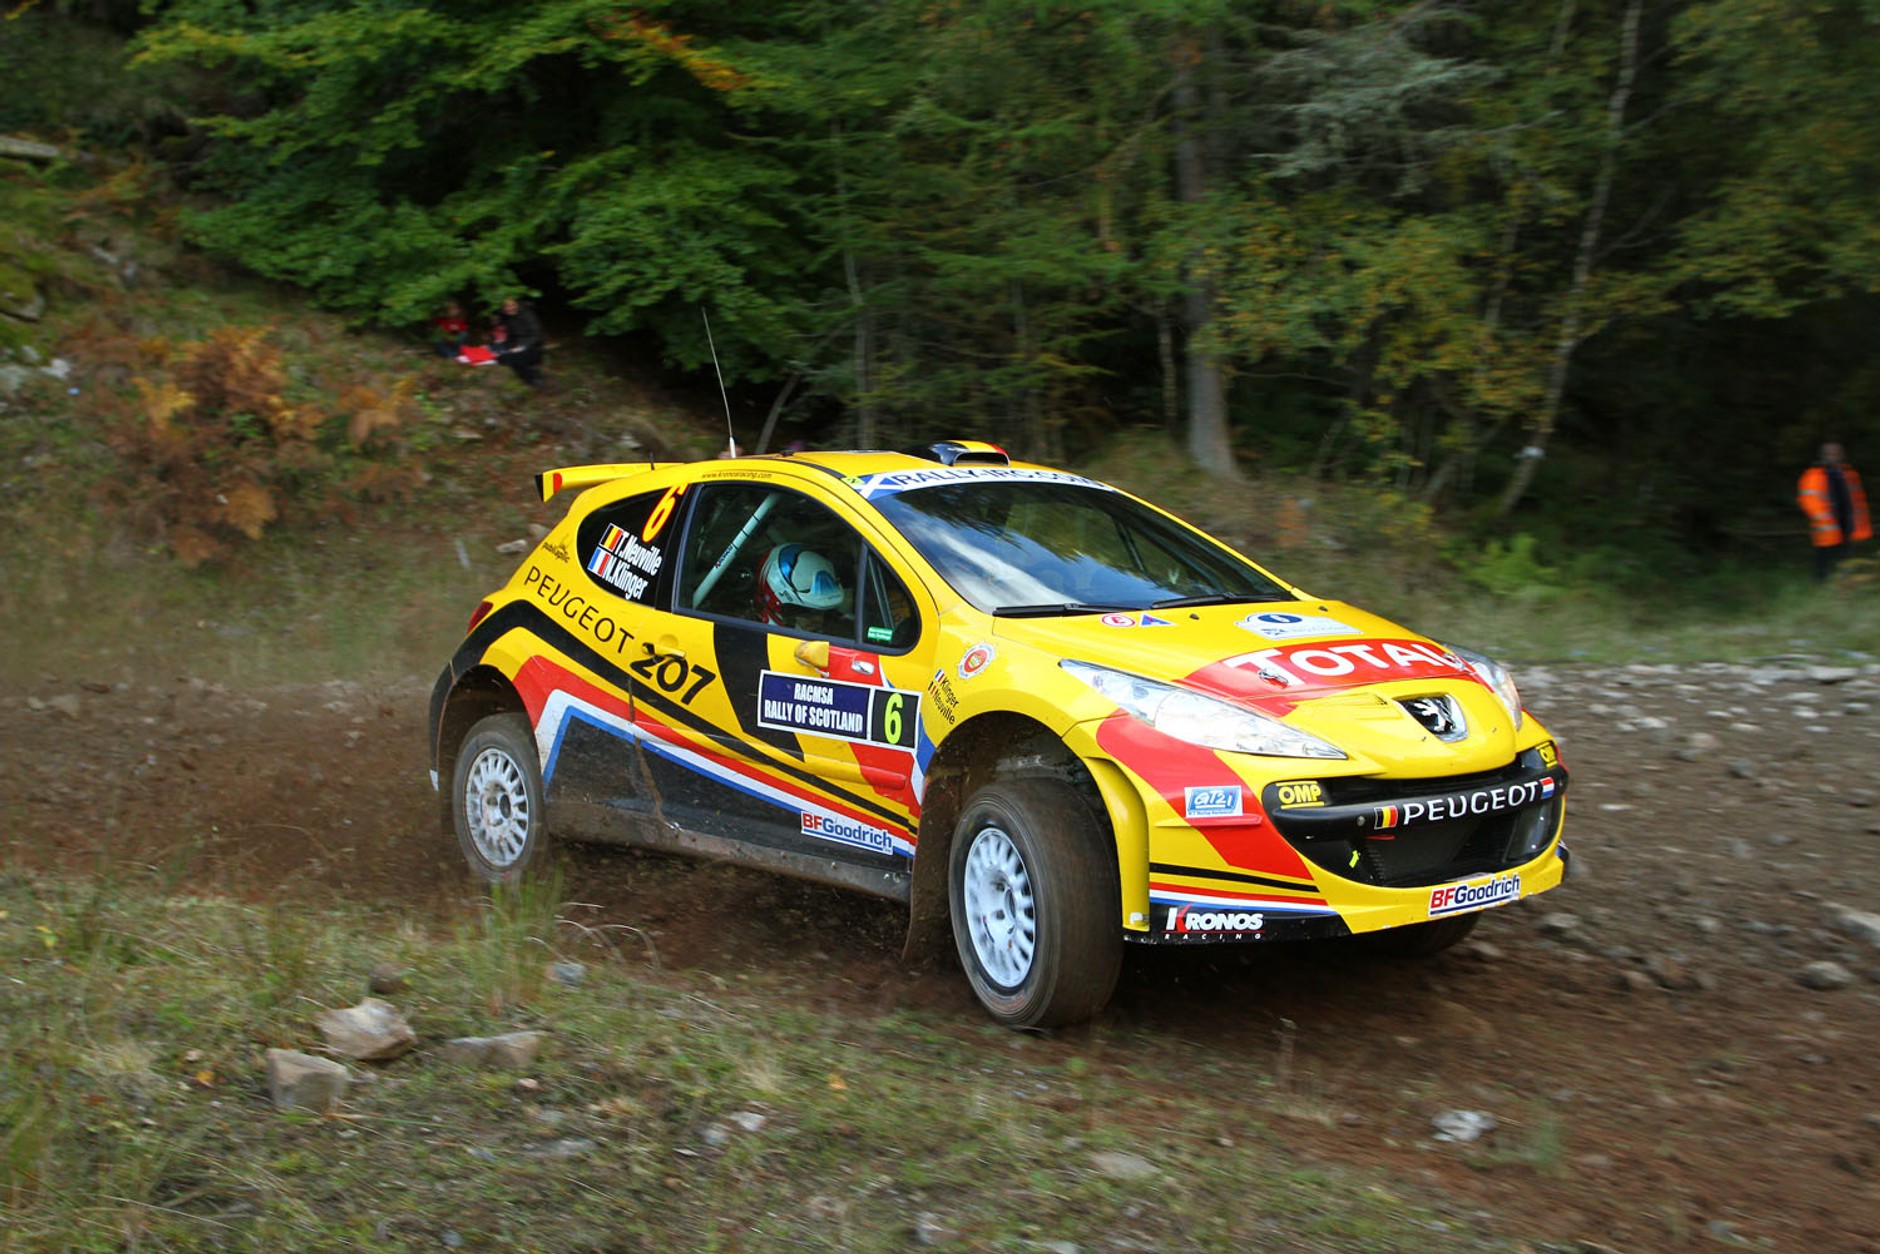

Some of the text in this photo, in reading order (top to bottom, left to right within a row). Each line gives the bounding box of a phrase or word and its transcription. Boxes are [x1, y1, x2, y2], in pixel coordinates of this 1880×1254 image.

[642, 482, 690, 542] 6
[614, 530, 662, 576] T.Neuville
[601, 555, 648, 600] N.Klinger
[523, 566, 635, 654] PEUGEOT
[629, 642, 716, 705] 207
[1222, 643, 1466, 687] TOTAL
[794, 682, 833, 705] RACMSA
[932, 689, 955, 725] Neuville
[941, 677, 959, 708] Klinger
[764, 700, 863, 733] RALLY OF SCOTLAND
[884, 692, 902, 744] 6
[1278, 784, 1322, 804] OMP
[1403, 781, 1539, 825] PEUGEOT
[802, 811, 892, 848] BFGoodrich
[1430, 874, 1520, 909] BFGoodrich
[1166, 902, 1263, 933] KRONOS
